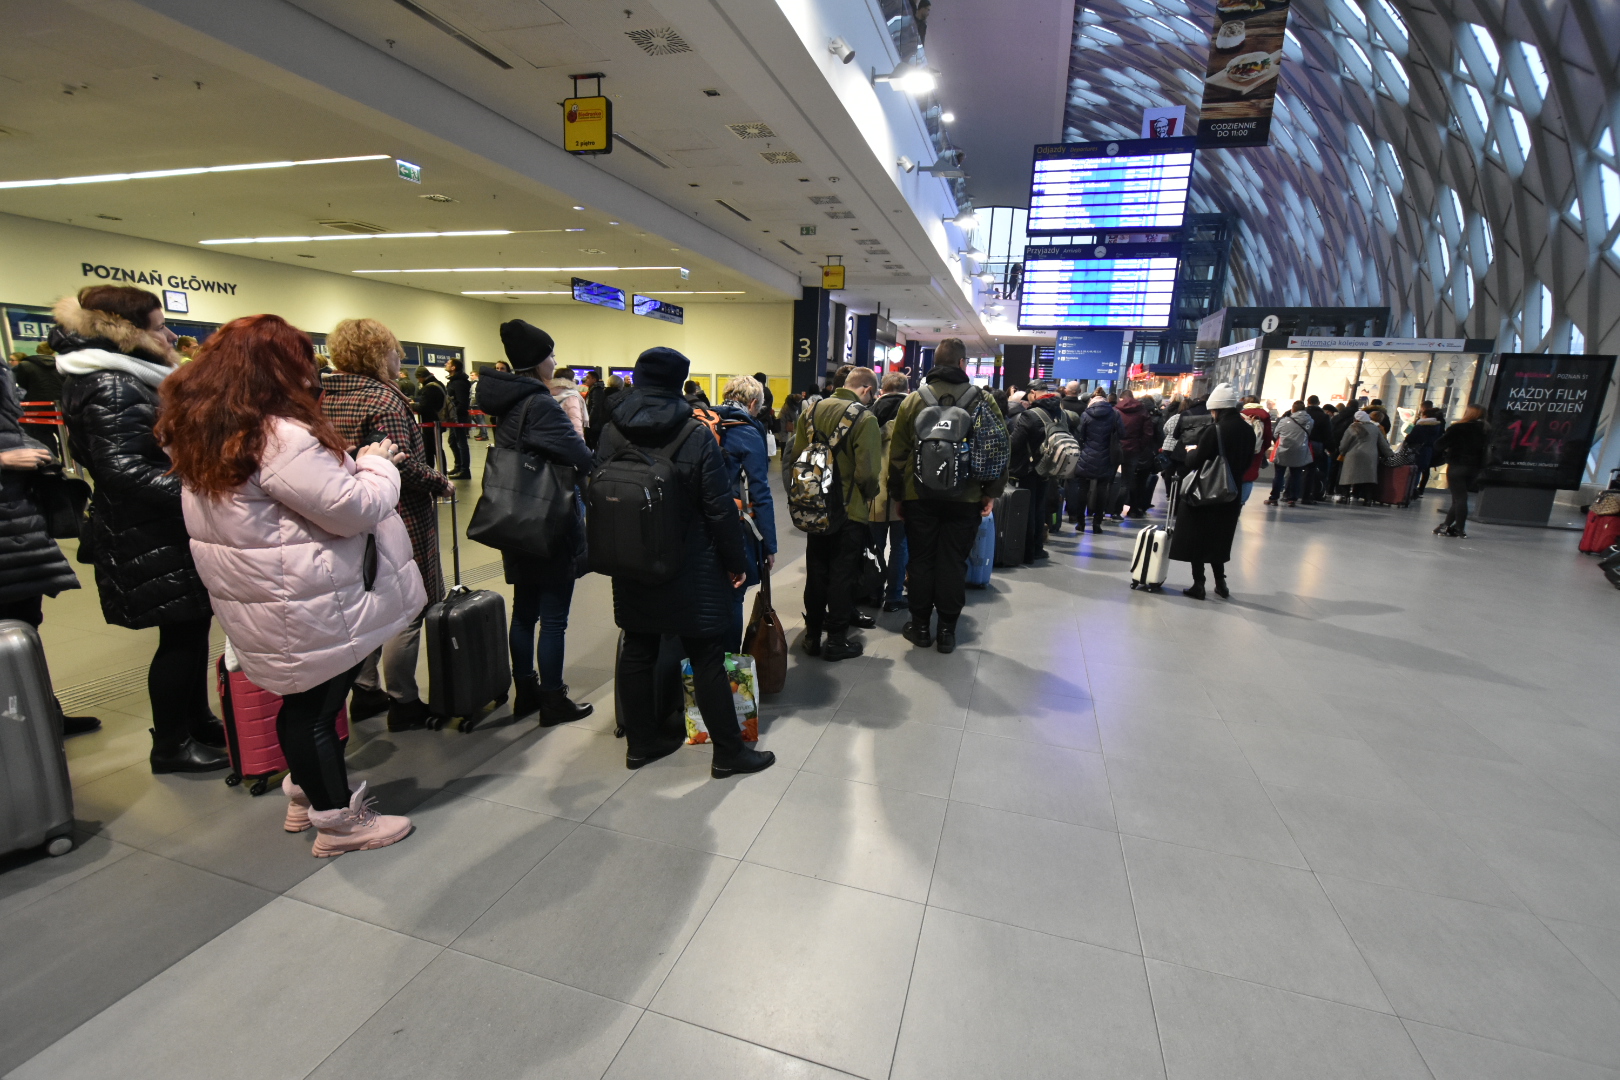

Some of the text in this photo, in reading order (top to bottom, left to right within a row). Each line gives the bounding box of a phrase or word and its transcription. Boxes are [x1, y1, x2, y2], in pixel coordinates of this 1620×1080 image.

[1210, 122, 1258, 130] CODZIENNIE
[1036, 145, 1066, 154] Odjazdy
[1026, 247, 1060, 255] Przyjazdy
[81, 262, 238, 296] POZNAŃ GŁÓWNY
[798, 337, 811, 358] 3
[904, 366, 912, 378] 2
[1509, 386, 1588, 400] KAŻDY FILM
[1506, 400, 1584, 413] KAŻDY DZIEŃ
[1507, 419, 1540, 452] 14
